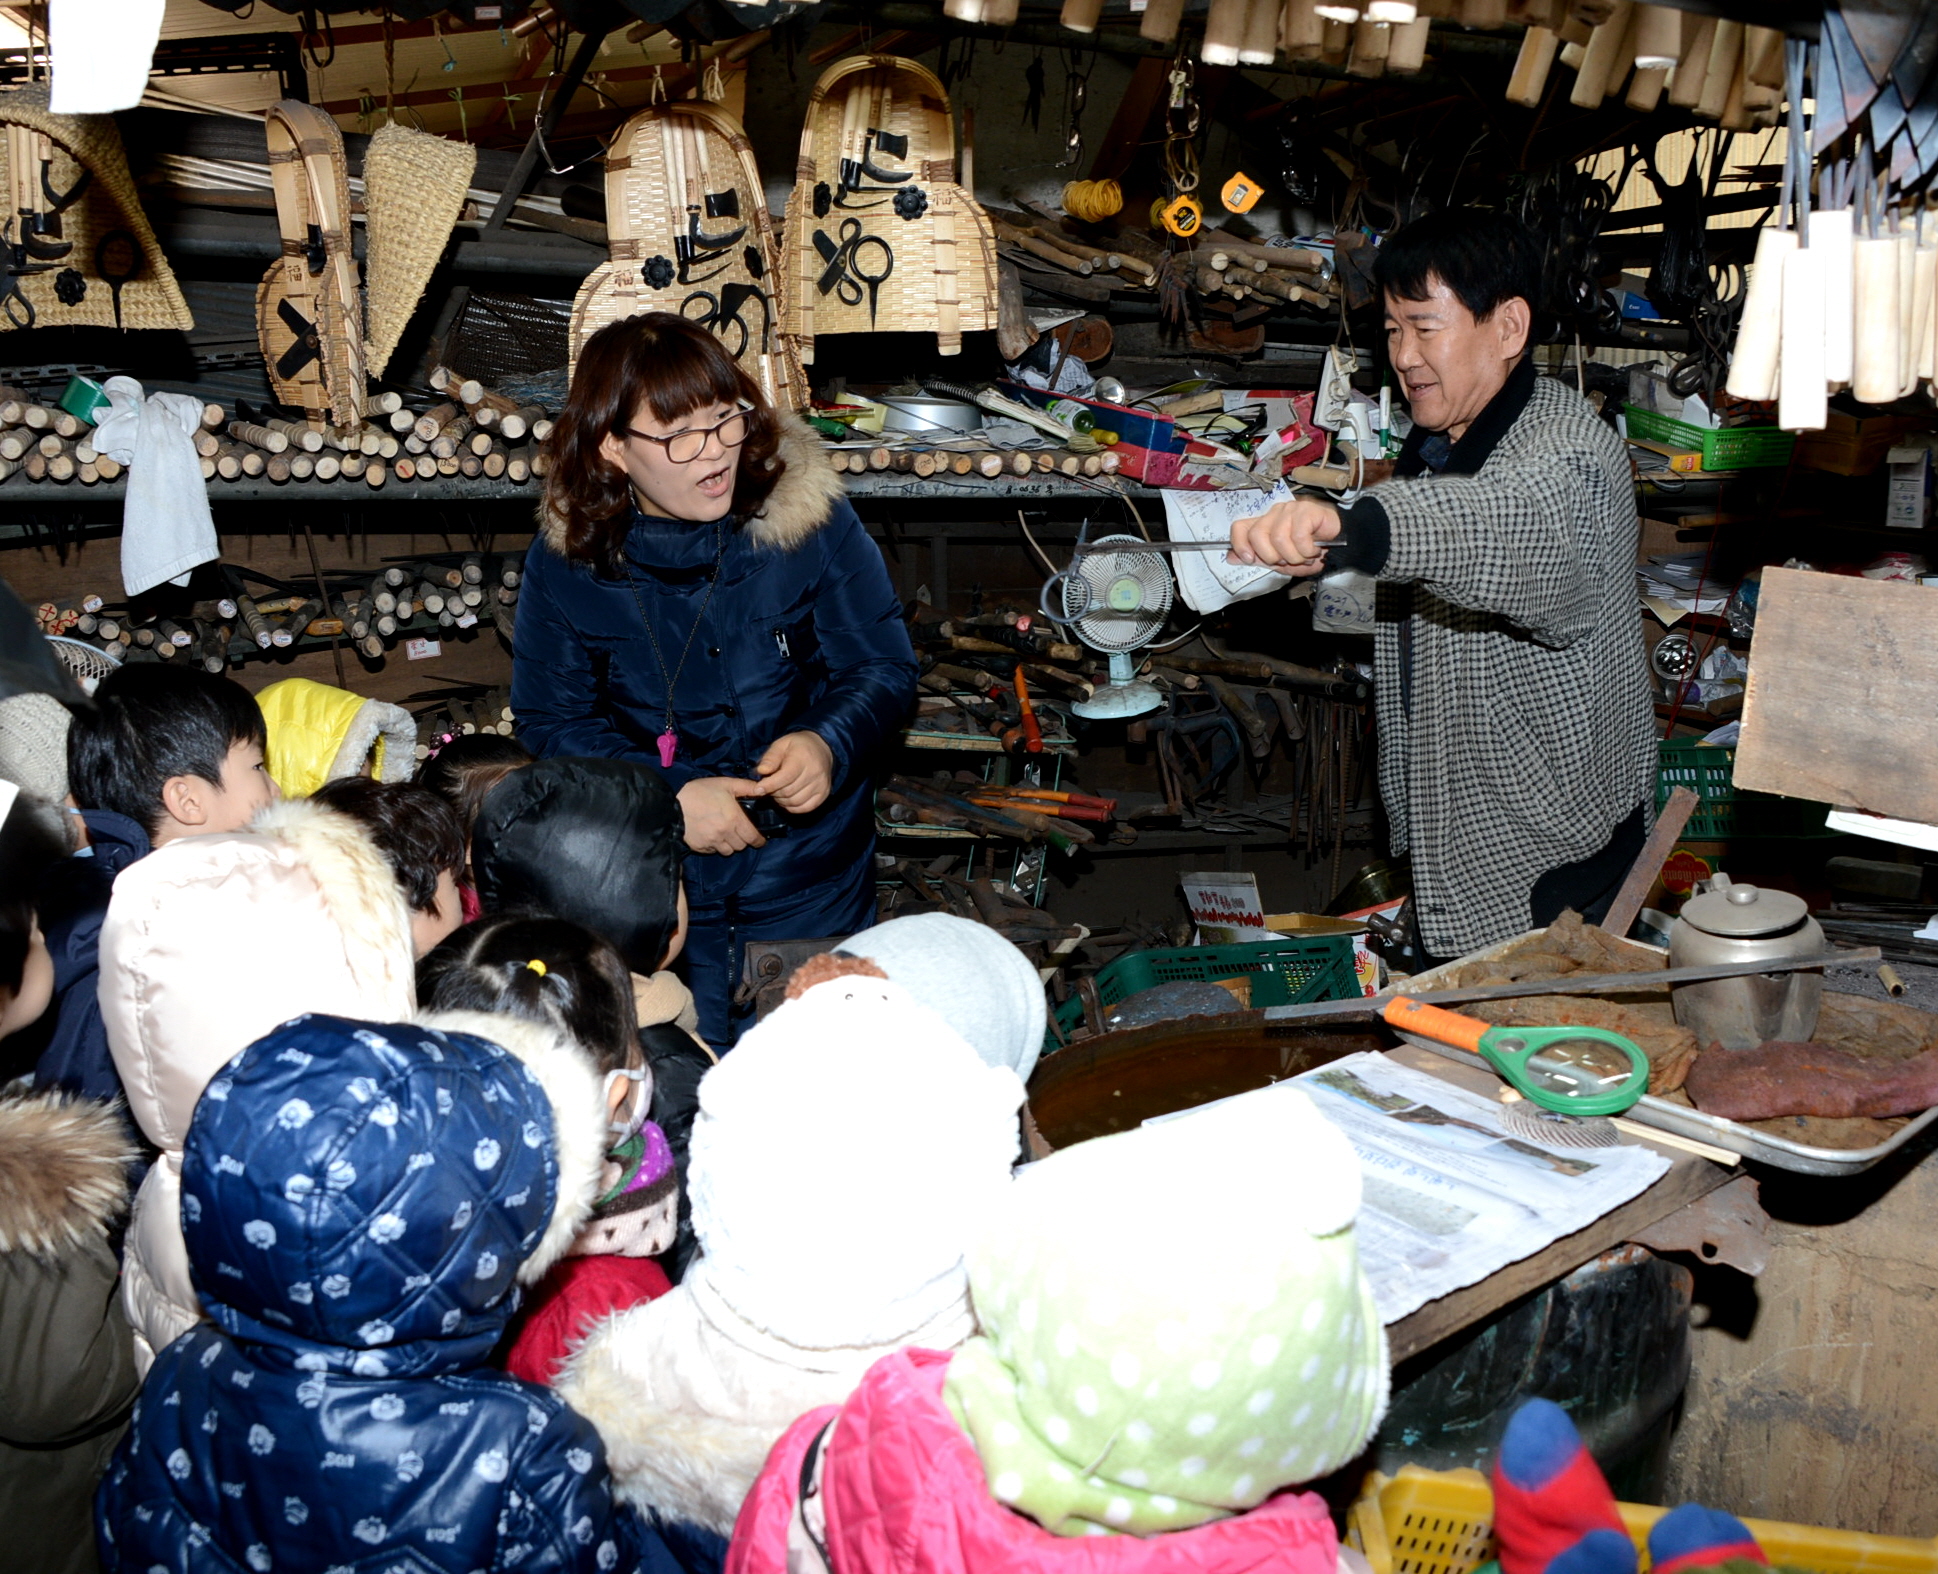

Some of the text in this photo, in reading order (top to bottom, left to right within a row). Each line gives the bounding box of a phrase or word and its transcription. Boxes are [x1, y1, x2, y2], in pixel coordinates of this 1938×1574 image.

[932, 188, 952, 206] 福
[286, 264, 303, 282] 福
[1663, 869, 1692, 883] Monte
